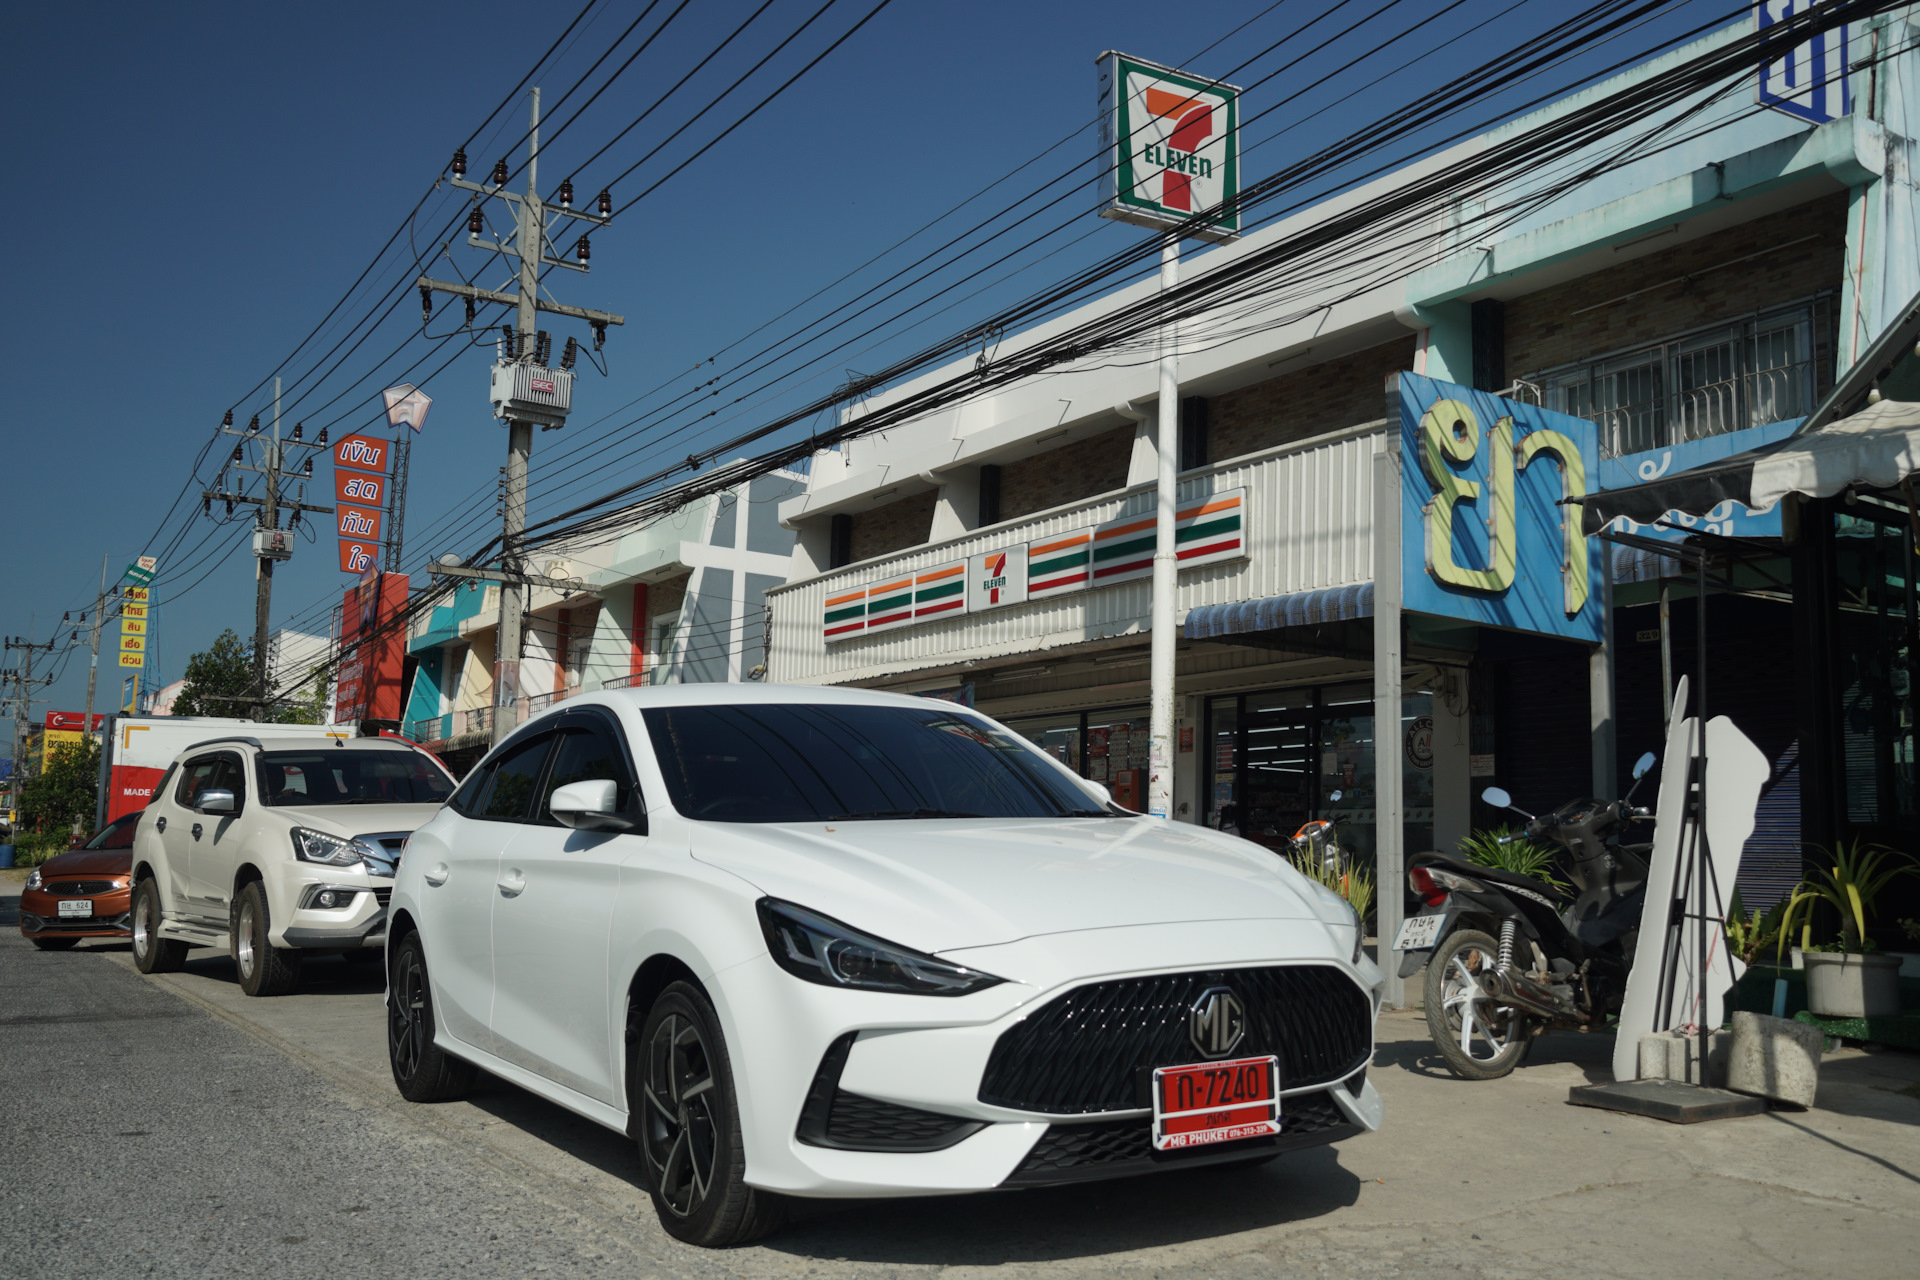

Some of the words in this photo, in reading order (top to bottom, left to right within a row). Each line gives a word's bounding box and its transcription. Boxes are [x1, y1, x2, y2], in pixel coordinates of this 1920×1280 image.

[532, 380, 553, 391] SEC
[339, 440, 381, 466] เงิน
[344, 478, 378, 500] สด
[1418, 398, 1590, 616] ยา
[341, 511, 374, 535] ทัน
[348, 545, 371, 571] ใจ
[127, 605, 143, 616] ไทย
[127, 622, 140, 632] สิน
[123, 788, 151, 796] MADE
[1196, 993, 1242, 1052] MG
[1170, 1136, 1186, 1146] MG
[1189, 1129, 1229, 1145] PHUKET
